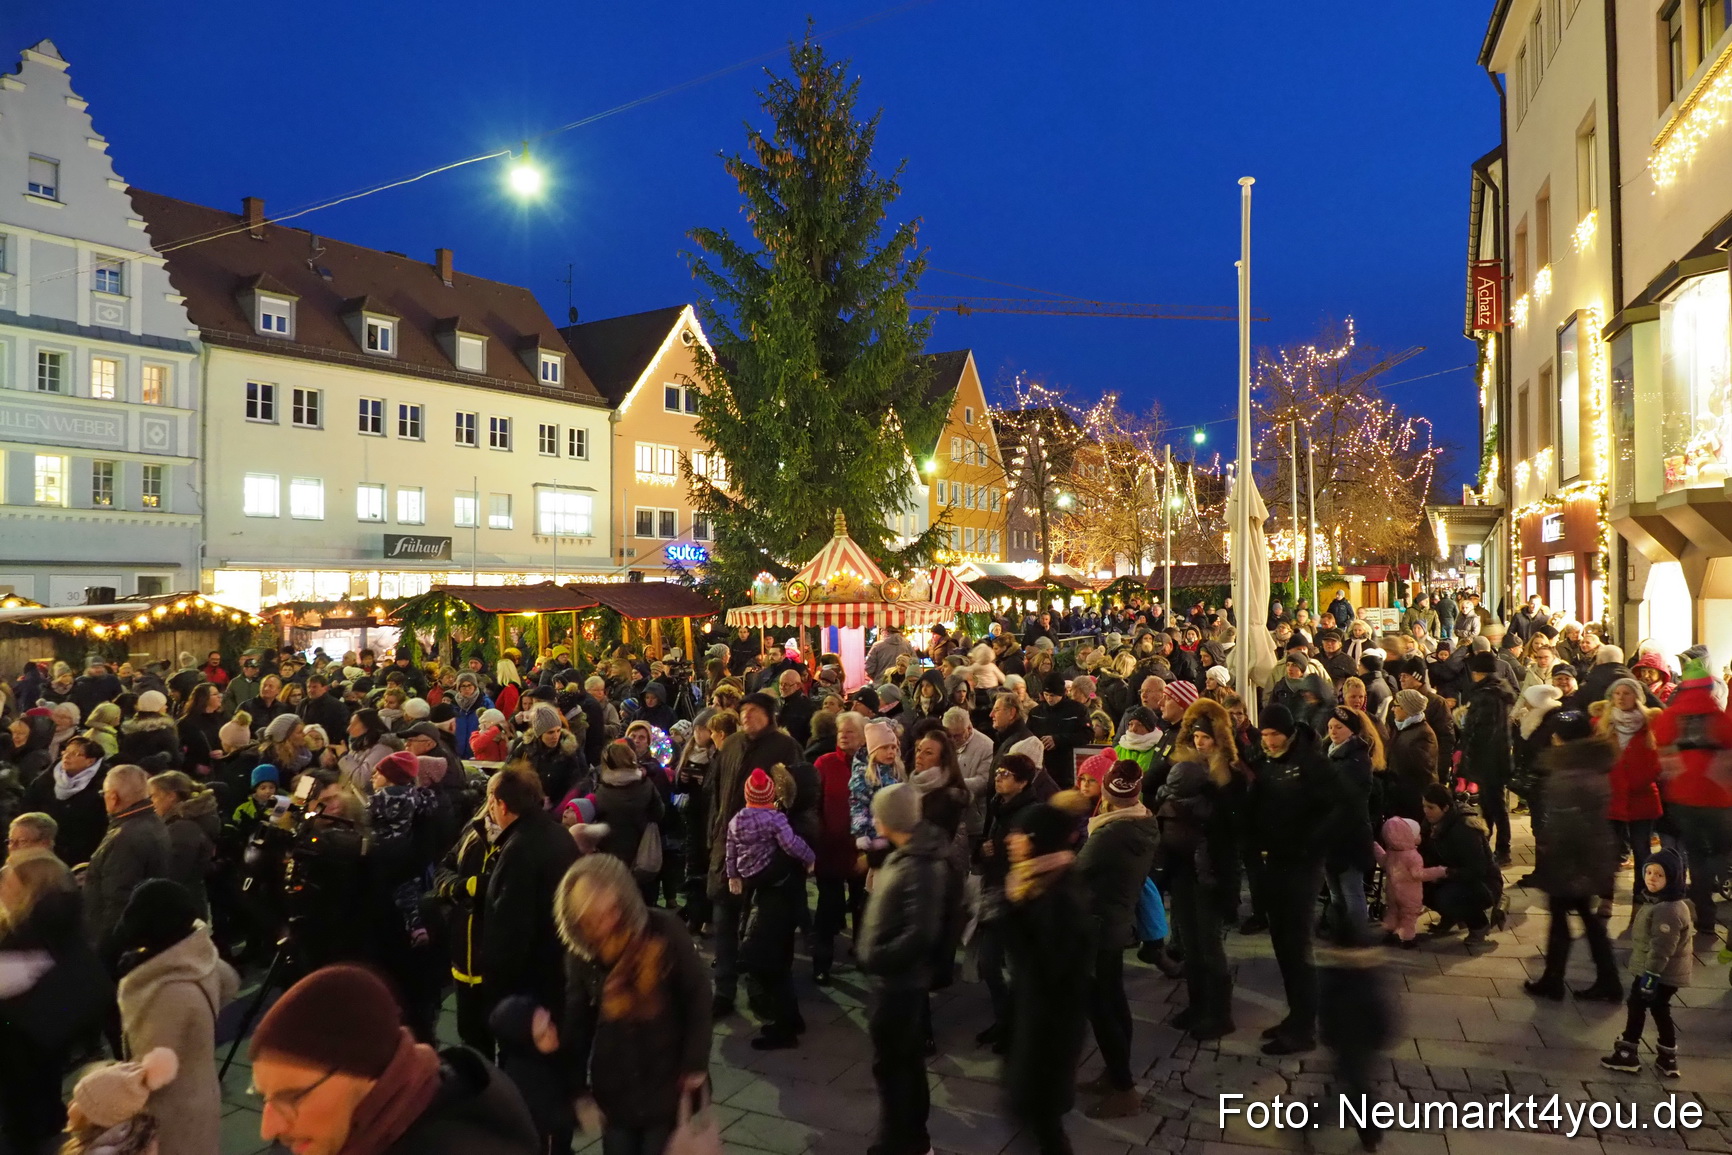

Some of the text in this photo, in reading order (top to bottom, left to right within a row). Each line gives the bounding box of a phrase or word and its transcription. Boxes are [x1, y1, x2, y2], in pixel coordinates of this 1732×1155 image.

[1477, 276, 1495, 325] Achatz
[53, 416, 116, 437] WEBER
[67, 591, 80, 601] 30
